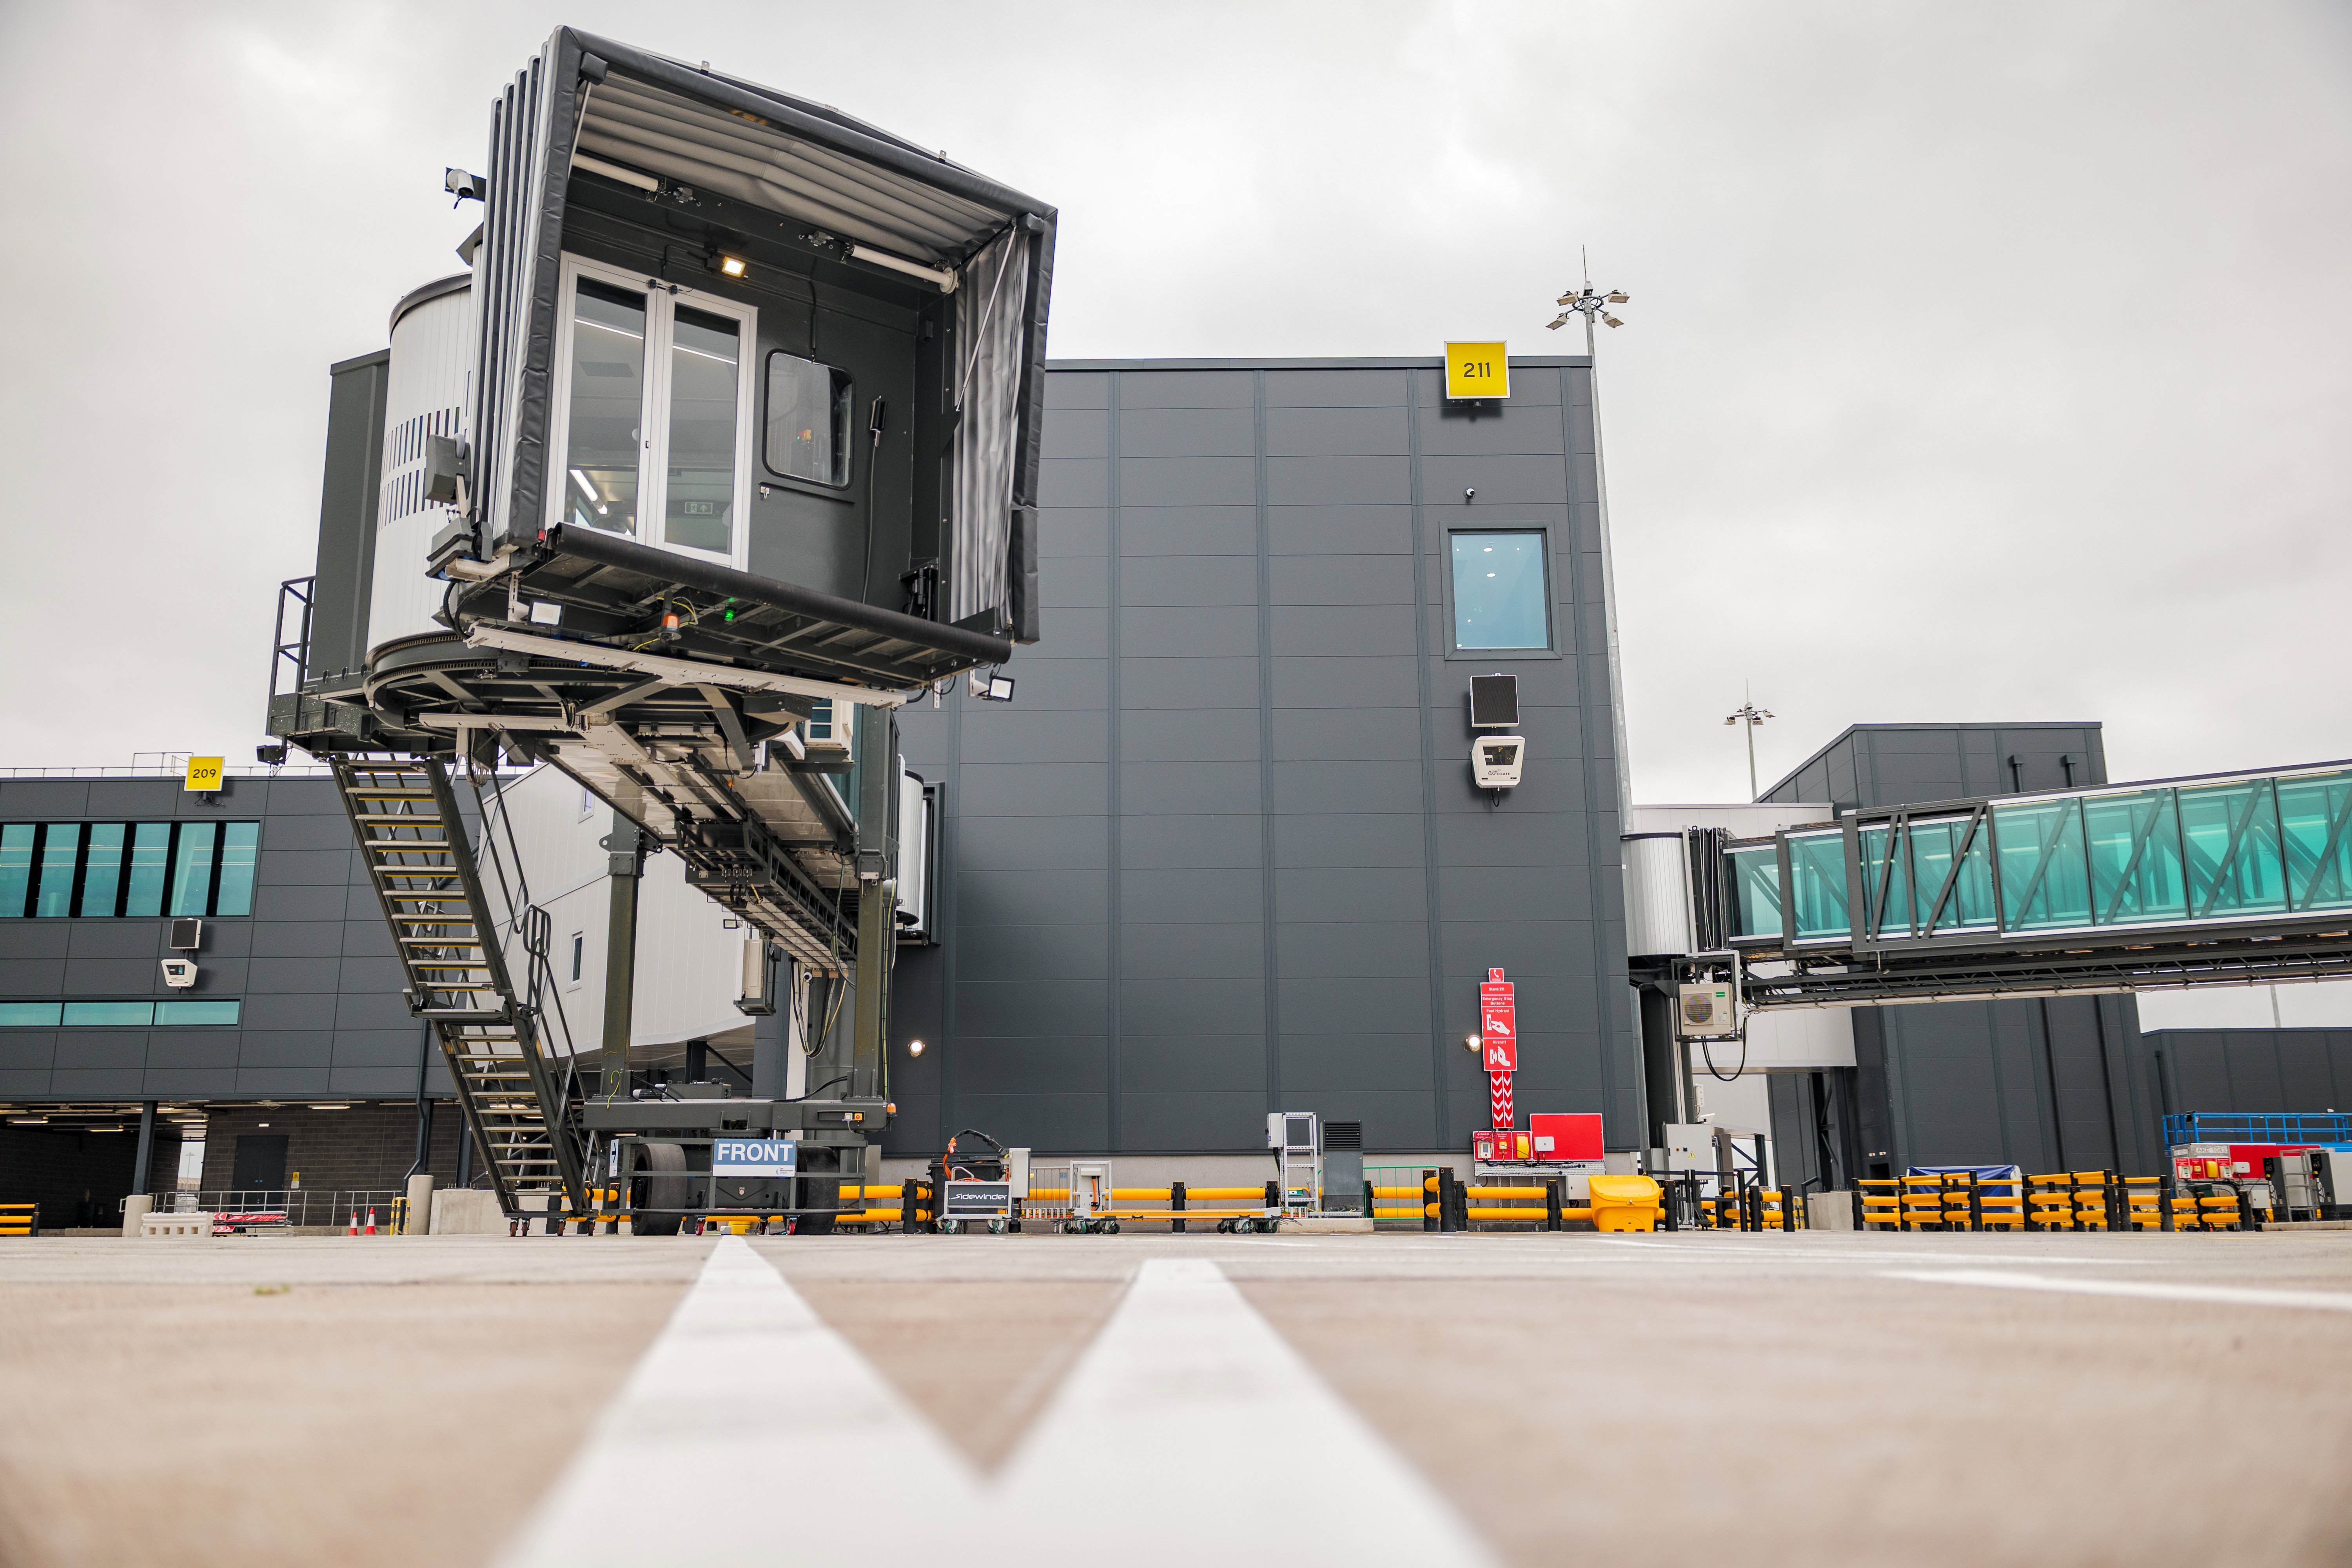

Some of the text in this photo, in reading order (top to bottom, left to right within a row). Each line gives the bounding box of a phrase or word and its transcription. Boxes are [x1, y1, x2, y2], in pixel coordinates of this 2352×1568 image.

[1464, 362, 1490, 377] 211
[193, 769, 216, 778] 209
[718, 1143, 793, 1161] FRONT
